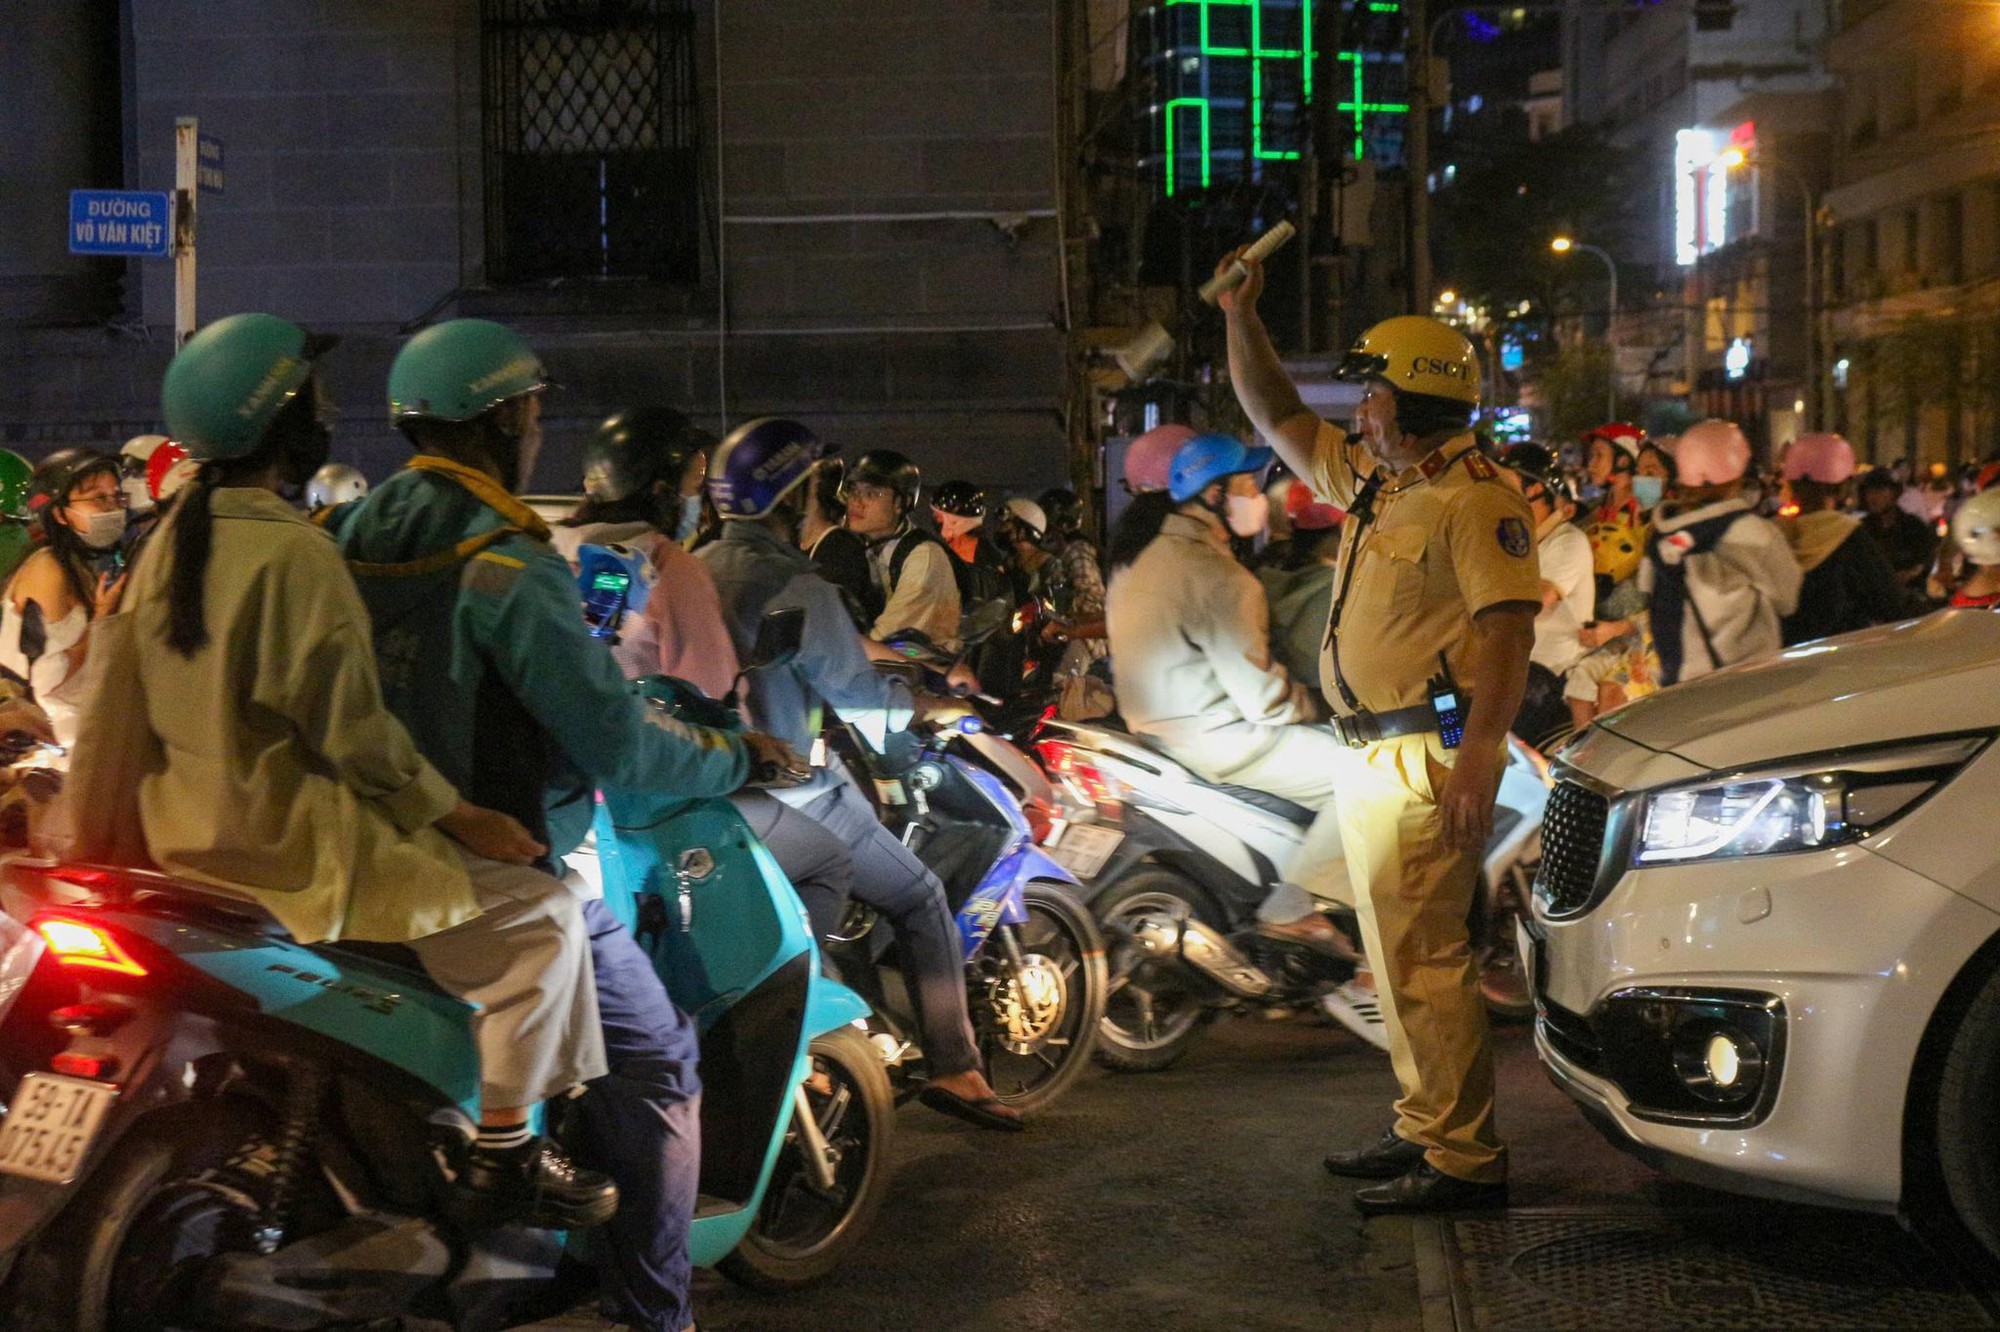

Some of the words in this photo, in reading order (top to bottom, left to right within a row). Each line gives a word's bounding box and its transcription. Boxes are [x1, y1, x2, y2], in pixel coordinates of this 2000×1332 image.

[88, 198, 151, 217] ĐƯỜNG
[76, 219, 94, 242] VÕ
[98, 219, 127, 243] VĂN
[131, 221, 162, 250] KIỆT
[1413, 356, 1471, 381] CSGT
